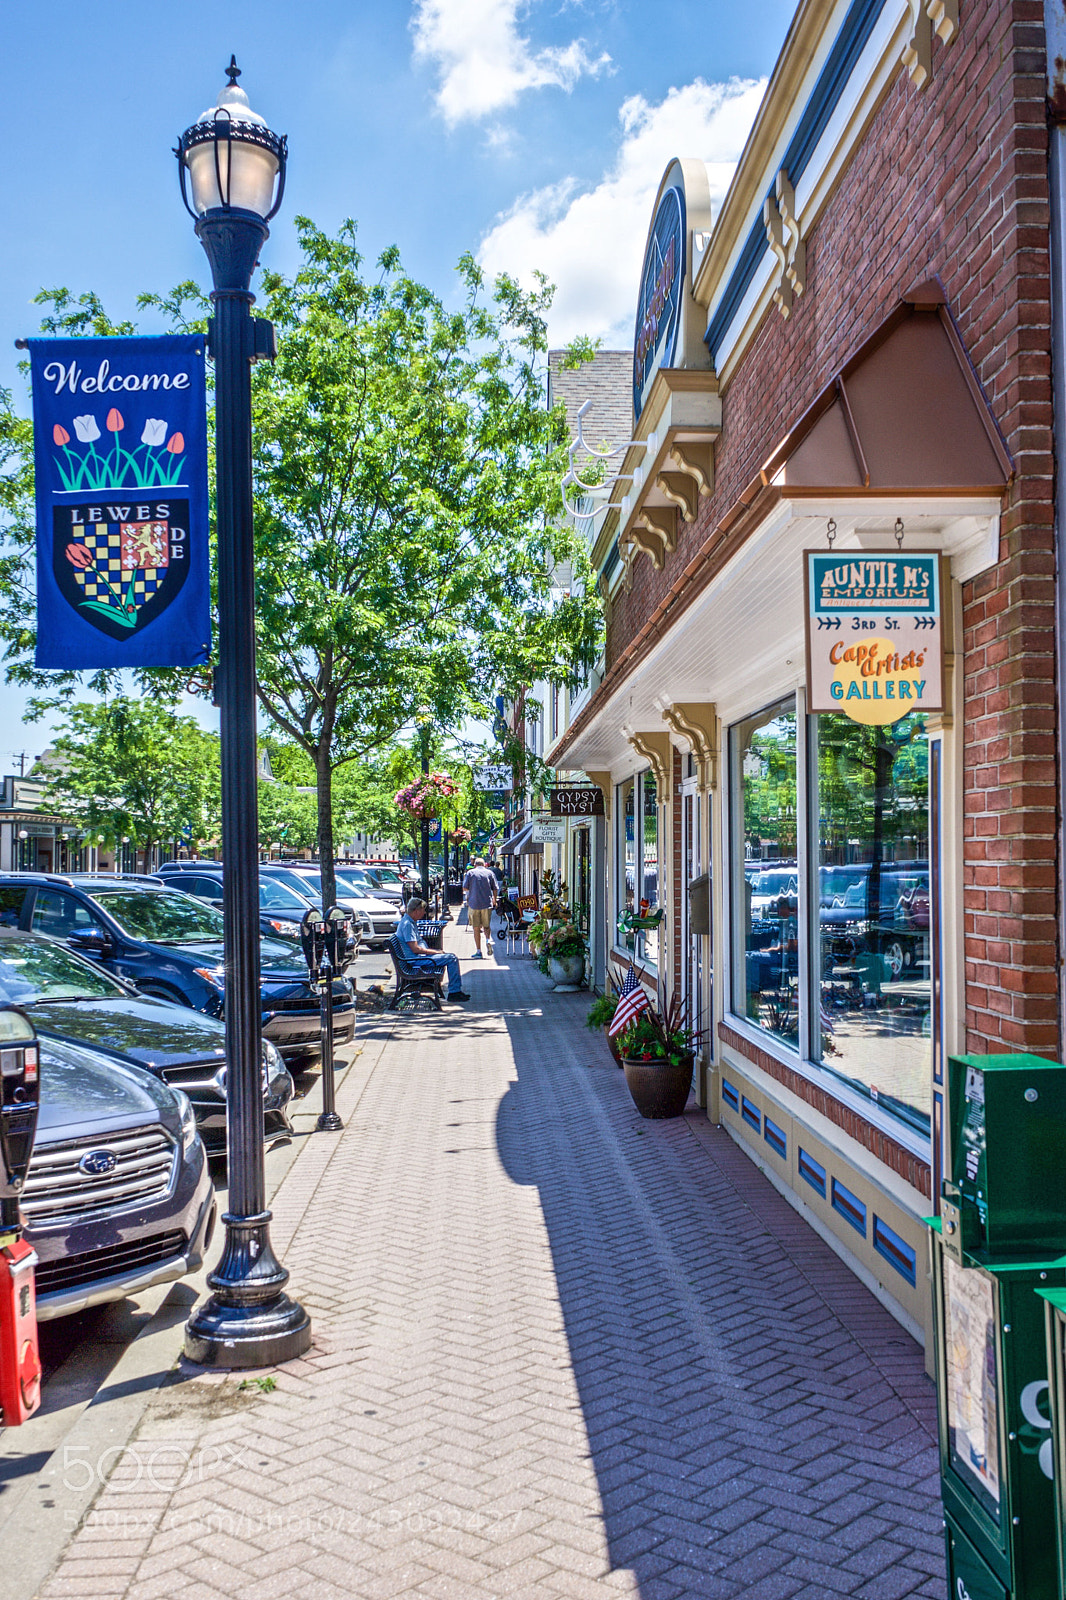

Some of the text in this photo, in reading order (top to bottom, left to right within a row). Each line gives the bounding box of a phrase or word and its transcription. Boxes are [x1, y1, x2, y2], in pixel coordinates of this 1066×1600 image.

[43, 359, 191, 395] Welcome
[71, 504, 171, 524] LEWES
[820, 561, 898, 588] AUNTIE
[821, 588, 928, 598] EMPORIUM
[826, 599, 866, 607] Antiques
[851, 616, 877, 630] 3RD
[829, 640, 879, 666] Cape
[830, 680, 926, 700] GALLERY
[556, 791, 598, 803] GYPSY
[560, 802, 595, 813] MYST
